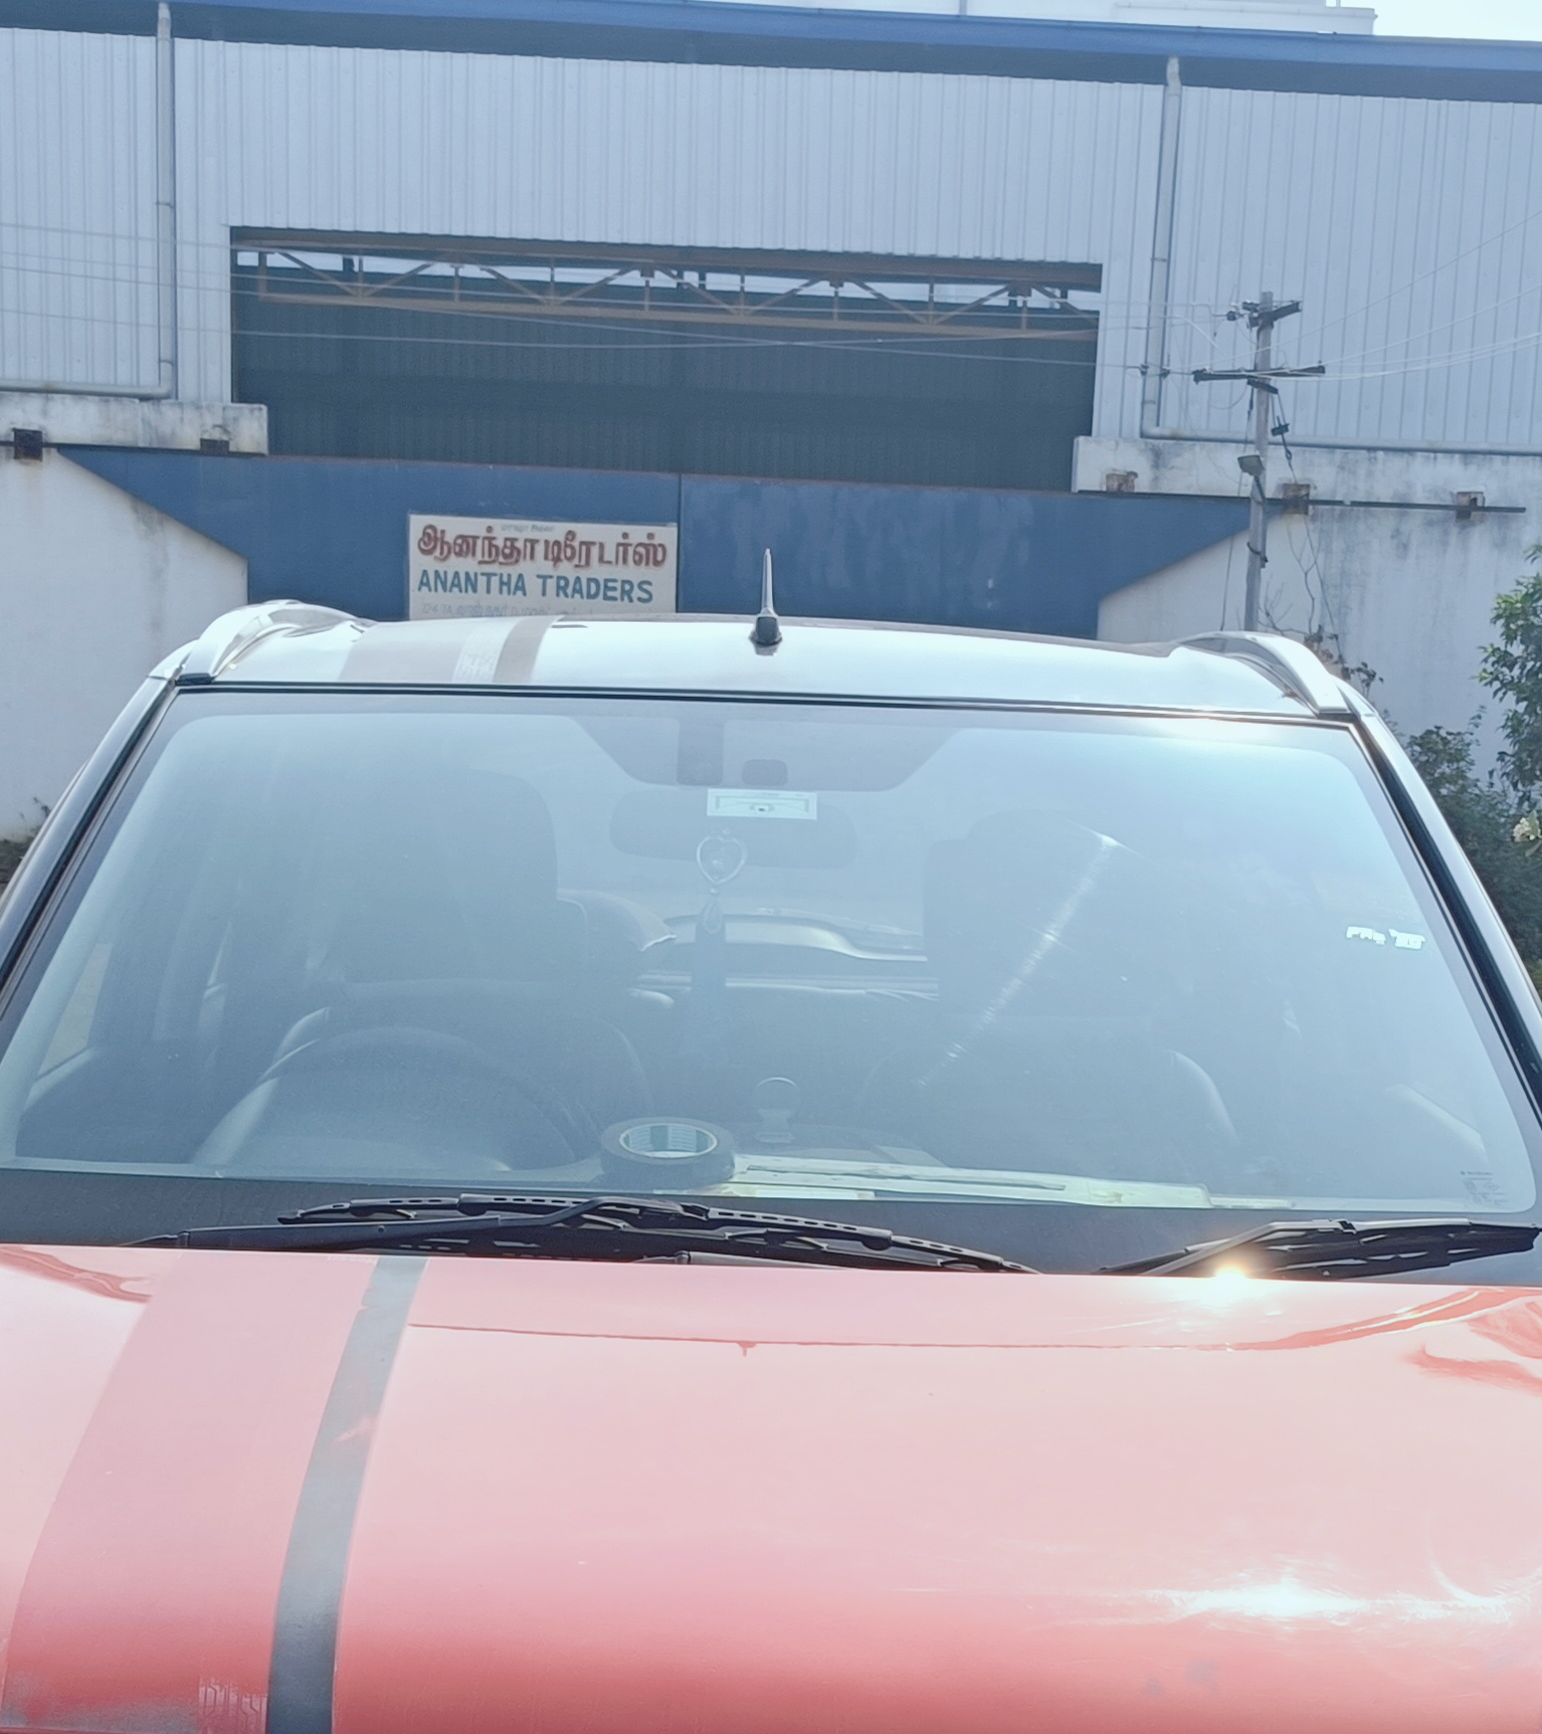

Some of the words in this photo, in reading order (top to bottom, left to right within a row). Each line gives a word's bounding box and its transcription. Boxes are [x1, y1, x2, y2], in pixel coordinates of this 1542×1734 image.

[417, 524, 540, 566] ஆனந்தா
[417, 569, 528, 597] ANANTHA
[535, 574, 654, 604] TRADERS
